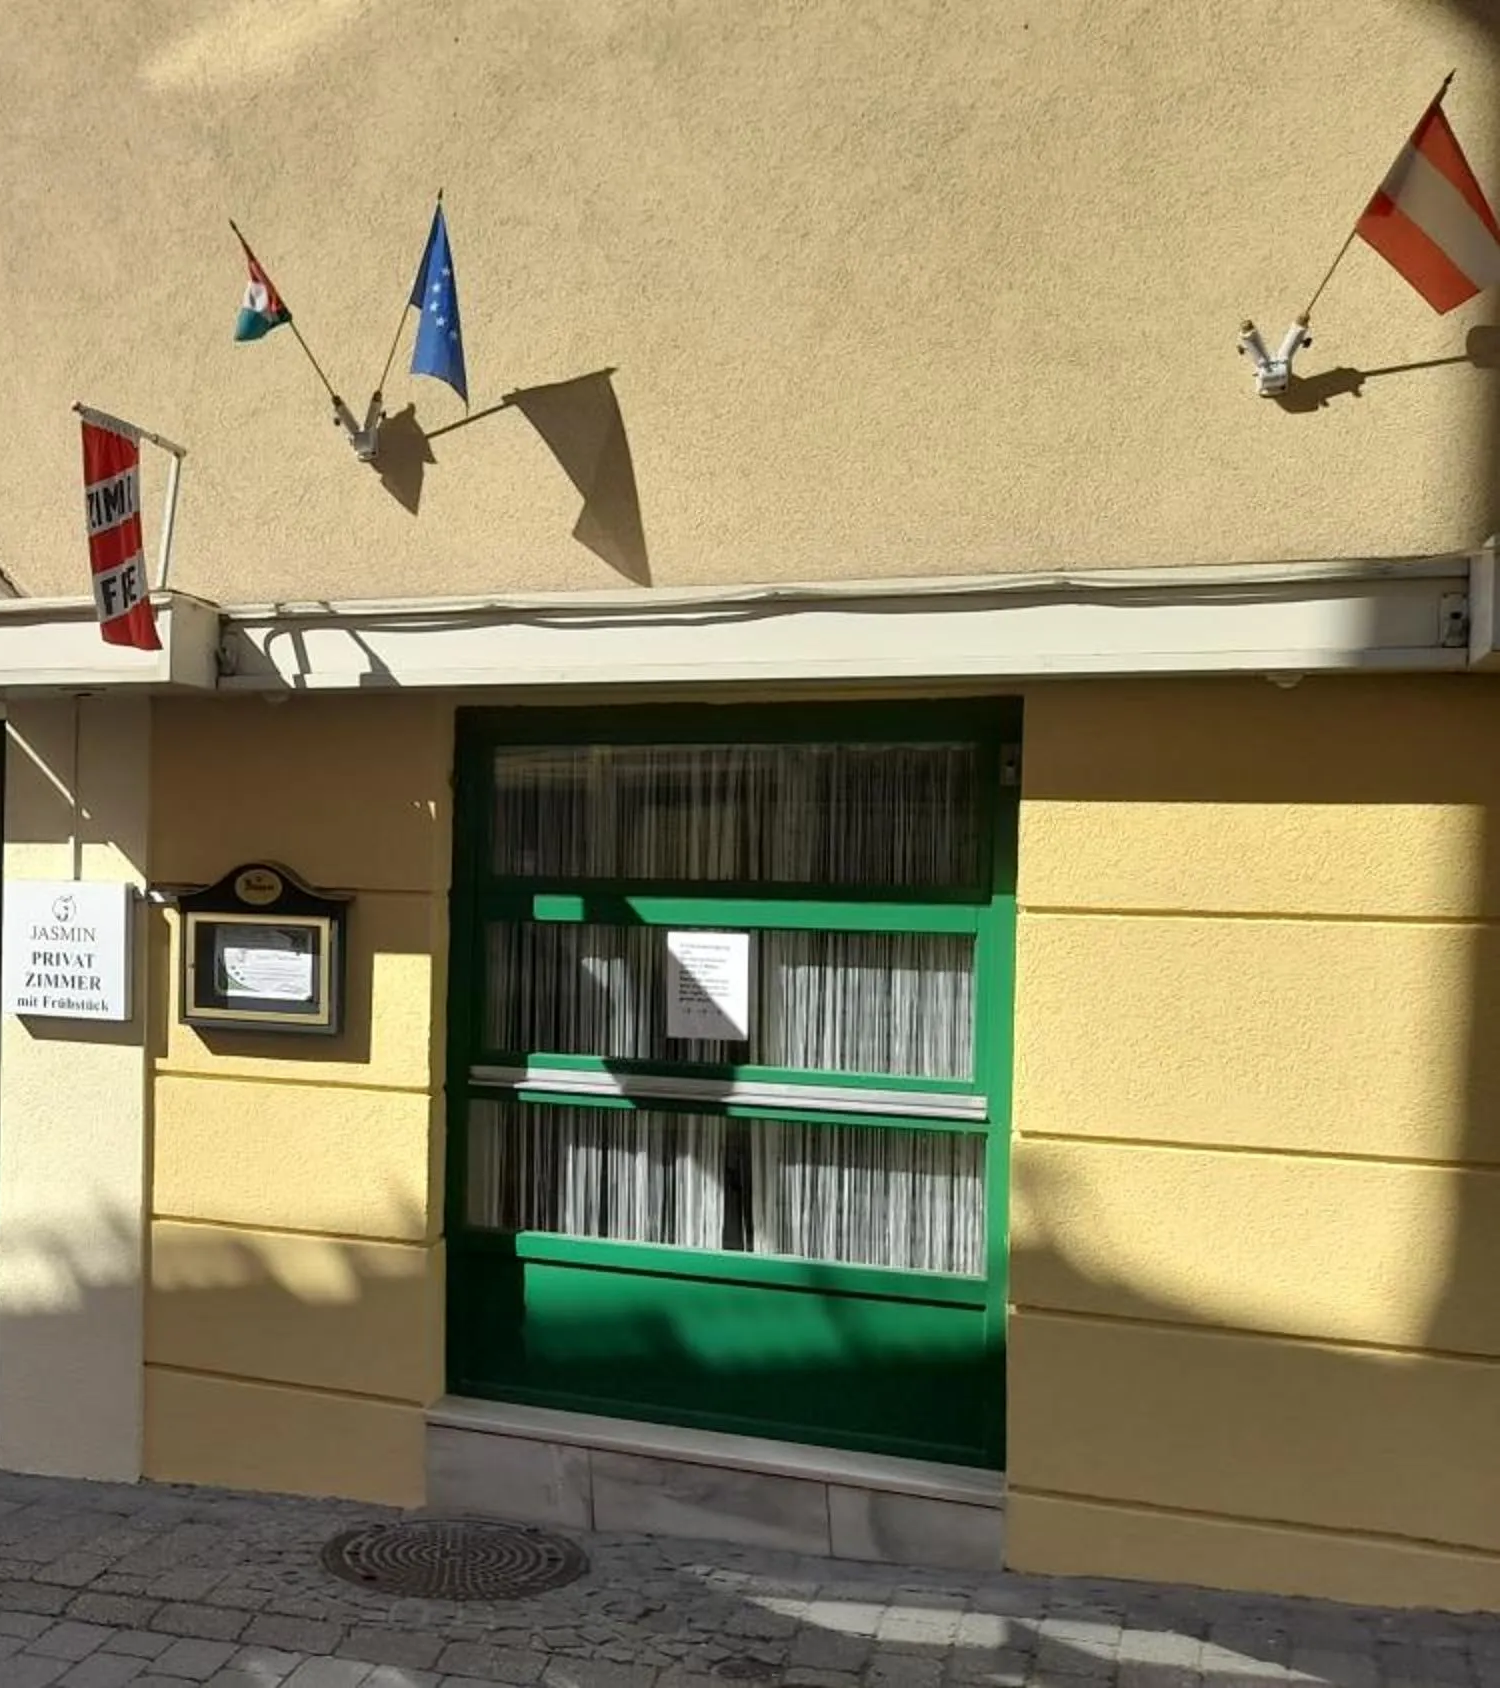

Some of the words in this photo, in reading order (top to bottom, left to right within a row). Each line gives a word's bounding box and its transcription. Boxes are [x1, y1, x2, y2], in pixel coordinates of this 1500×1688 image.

[30, 925, 97, 942] JASMIN
[32, 951, 95, 969] PRIVAT
[25, 972, 101, 991] ZIMMER
[17, 995, 38, 1007] mit
[43, 995, 109, 1012] Frühstück
